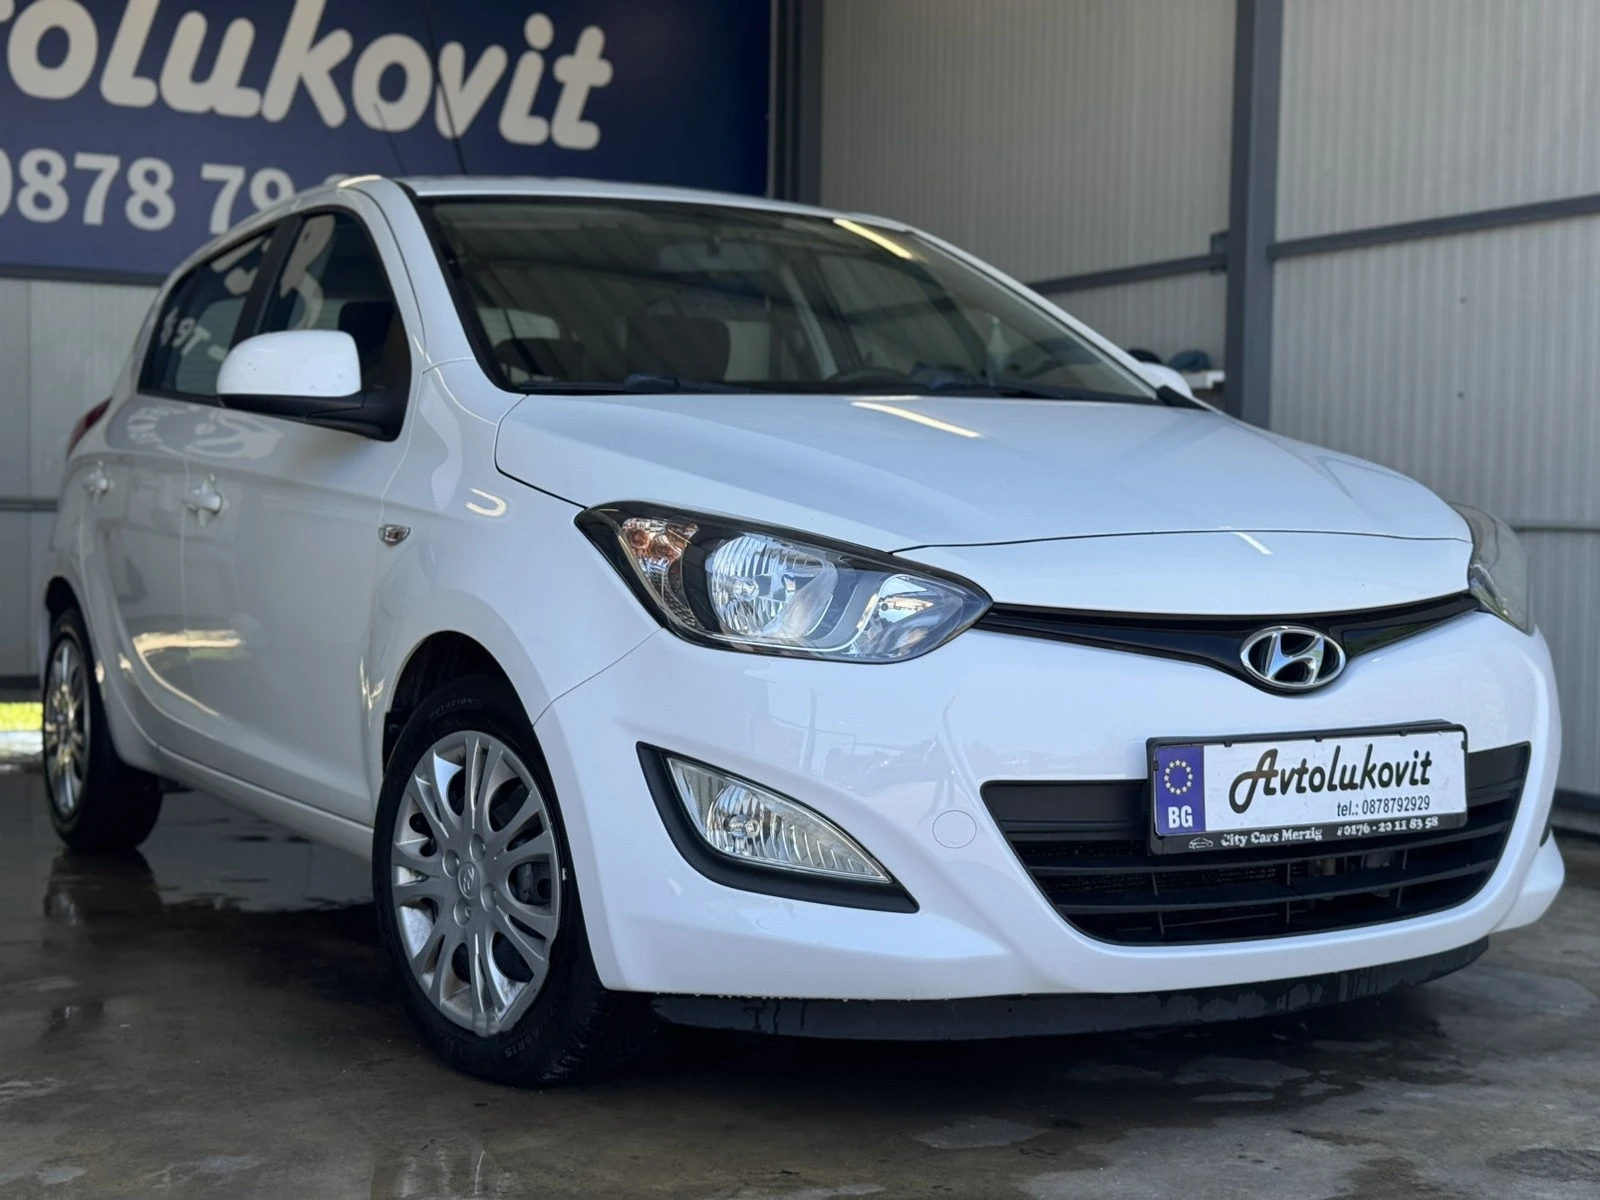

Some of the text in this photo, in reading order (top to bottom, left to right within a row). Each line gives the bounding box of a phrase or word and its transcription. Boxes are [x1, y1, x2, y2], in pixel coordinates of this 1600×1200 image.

[0, 0, 613, 150] olukovit
[0, 148, 175, 231] 878
[1228, 743, 1433, 814] Avtolukovit
[1167, 805, 1193, 829] BG
[1336, 795, 1431, 817] tel.: 0878792929
[1220, 833, 1248, 848] City
[1250, 831, 1279, 844] Cars
[1281, 826, 1323, 841] Merzig
[1394, 820, 1408, 831] 11
